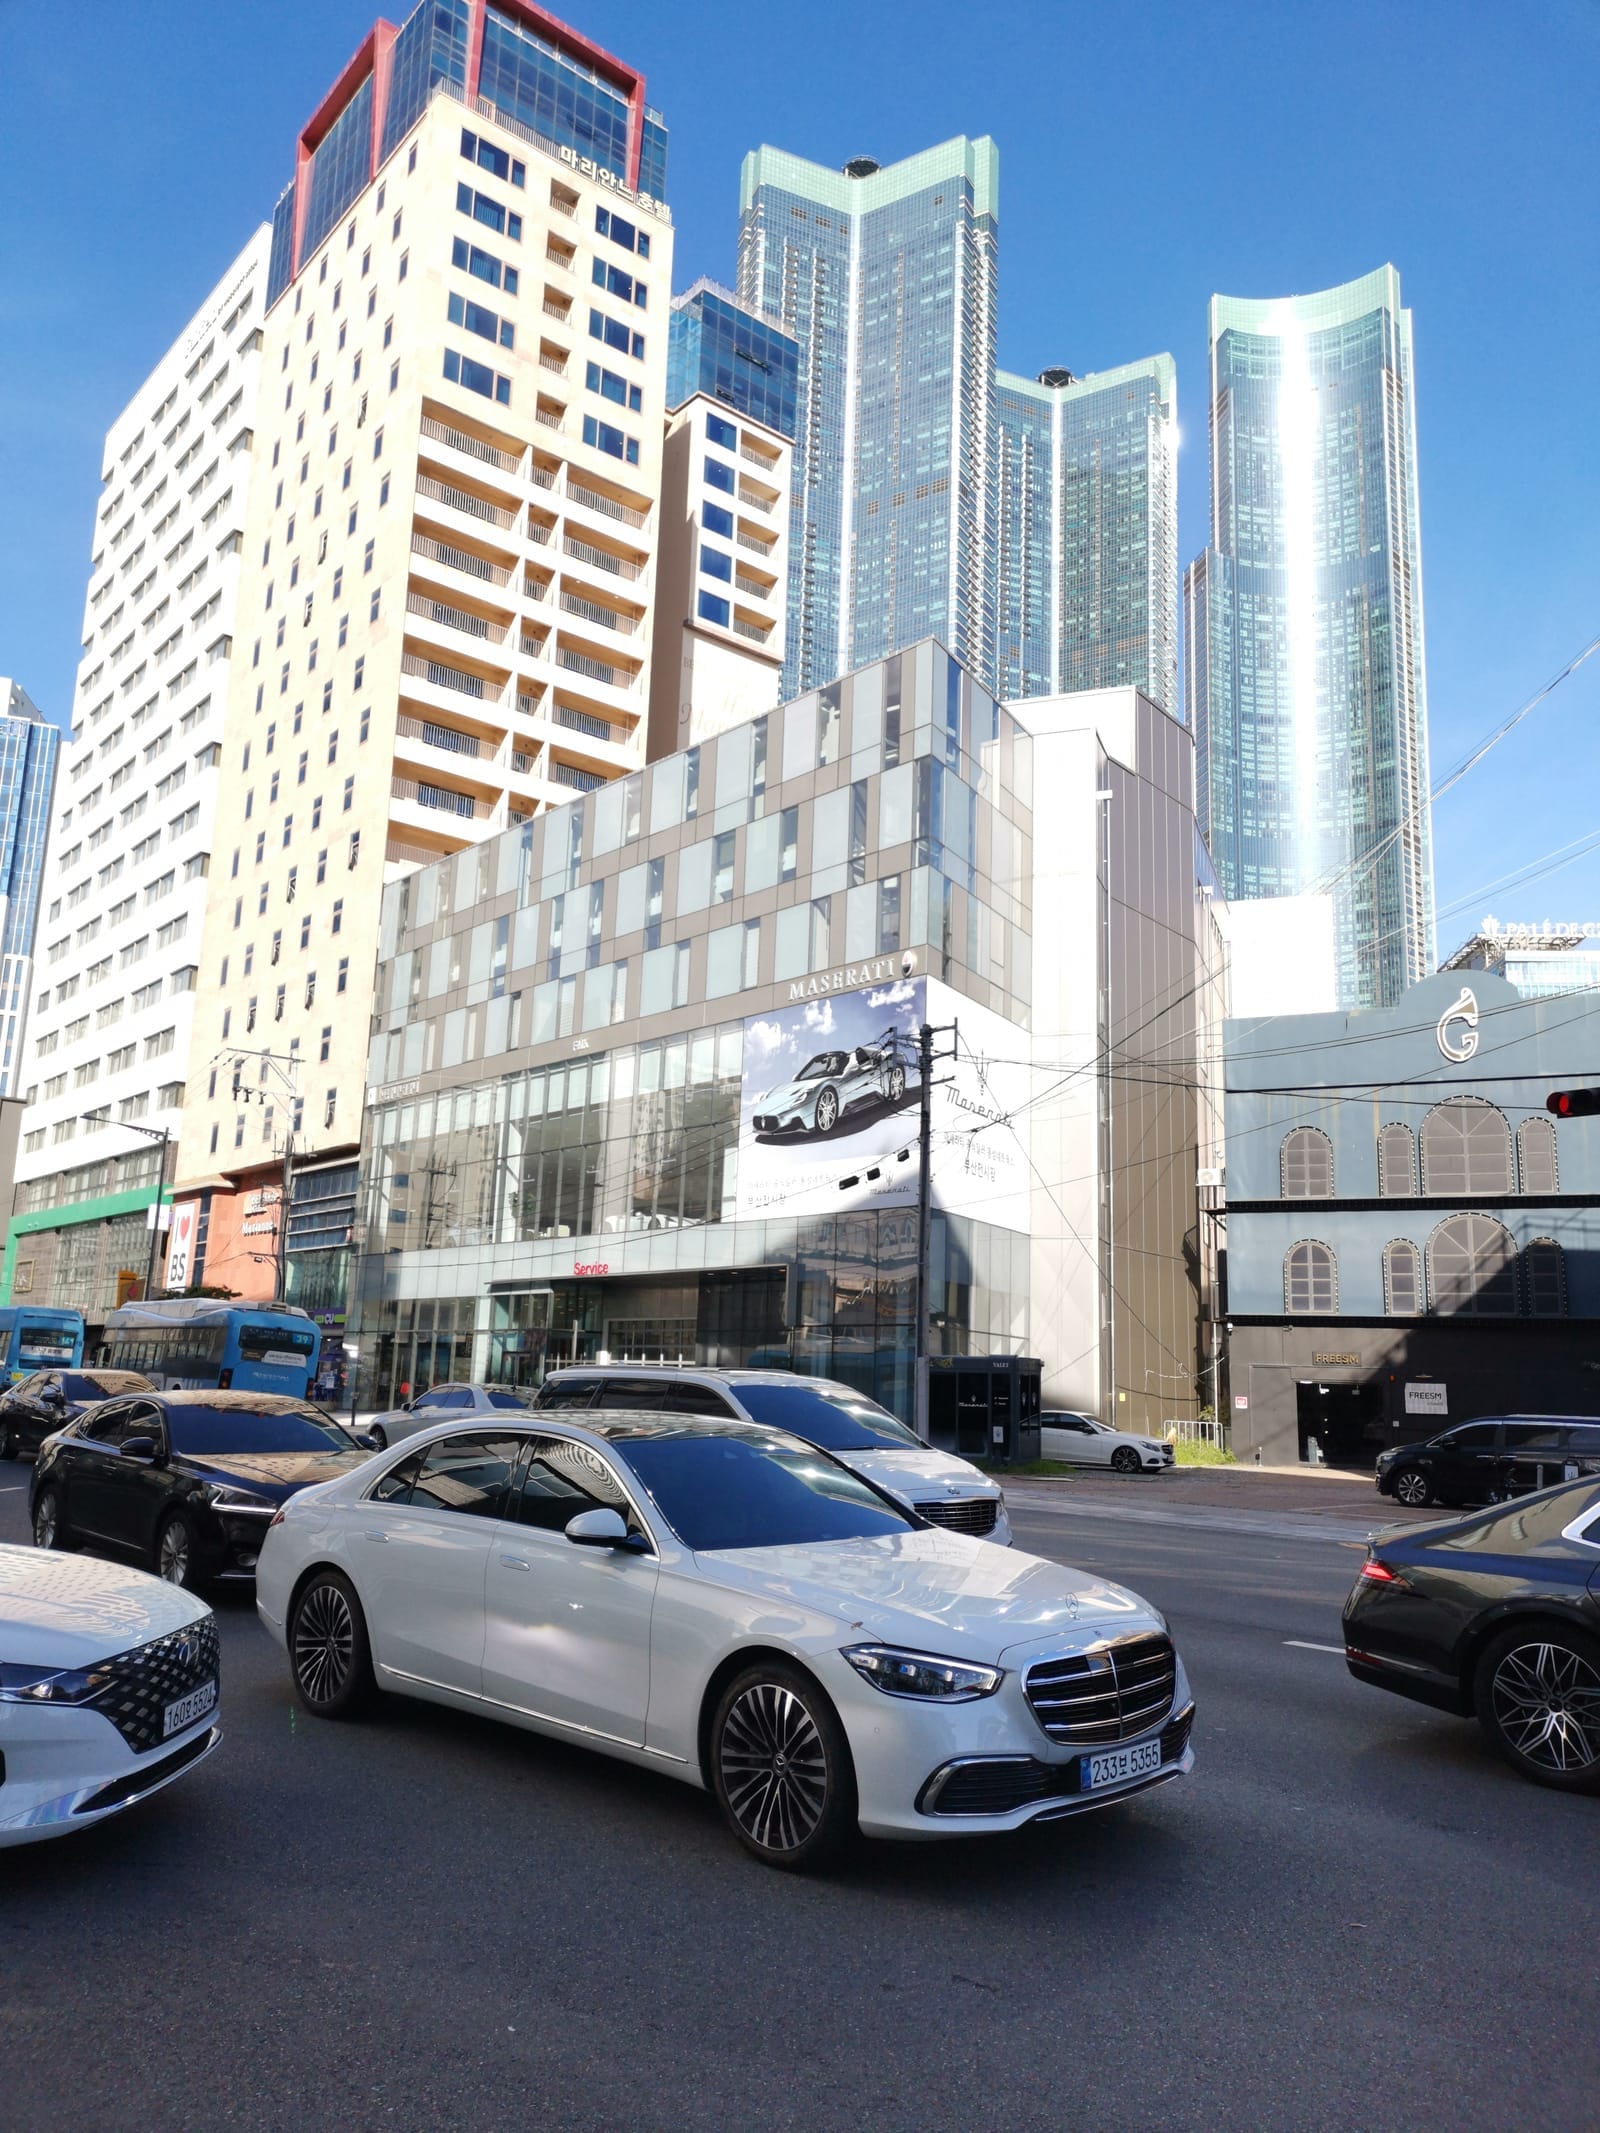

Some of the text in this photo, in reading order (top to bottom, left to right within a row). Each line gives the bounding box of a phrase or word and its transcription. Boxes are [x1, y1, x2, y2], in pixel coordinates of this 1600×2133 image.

[560, 145, 671, 223] 마리안느 호텔
[788, 958, 895, 1001] MASERATI
[170, 1252, 187, 1281] BS
[574, 1261, 609, 1275] Service
[324, 1313, 334, 1324] CU
[1315, 1353, 1359, 1364] FREESM
[1409, 1391, 1442, 1400] FREESM
[1092, 1743, 1159, 1784] 233보 5355
